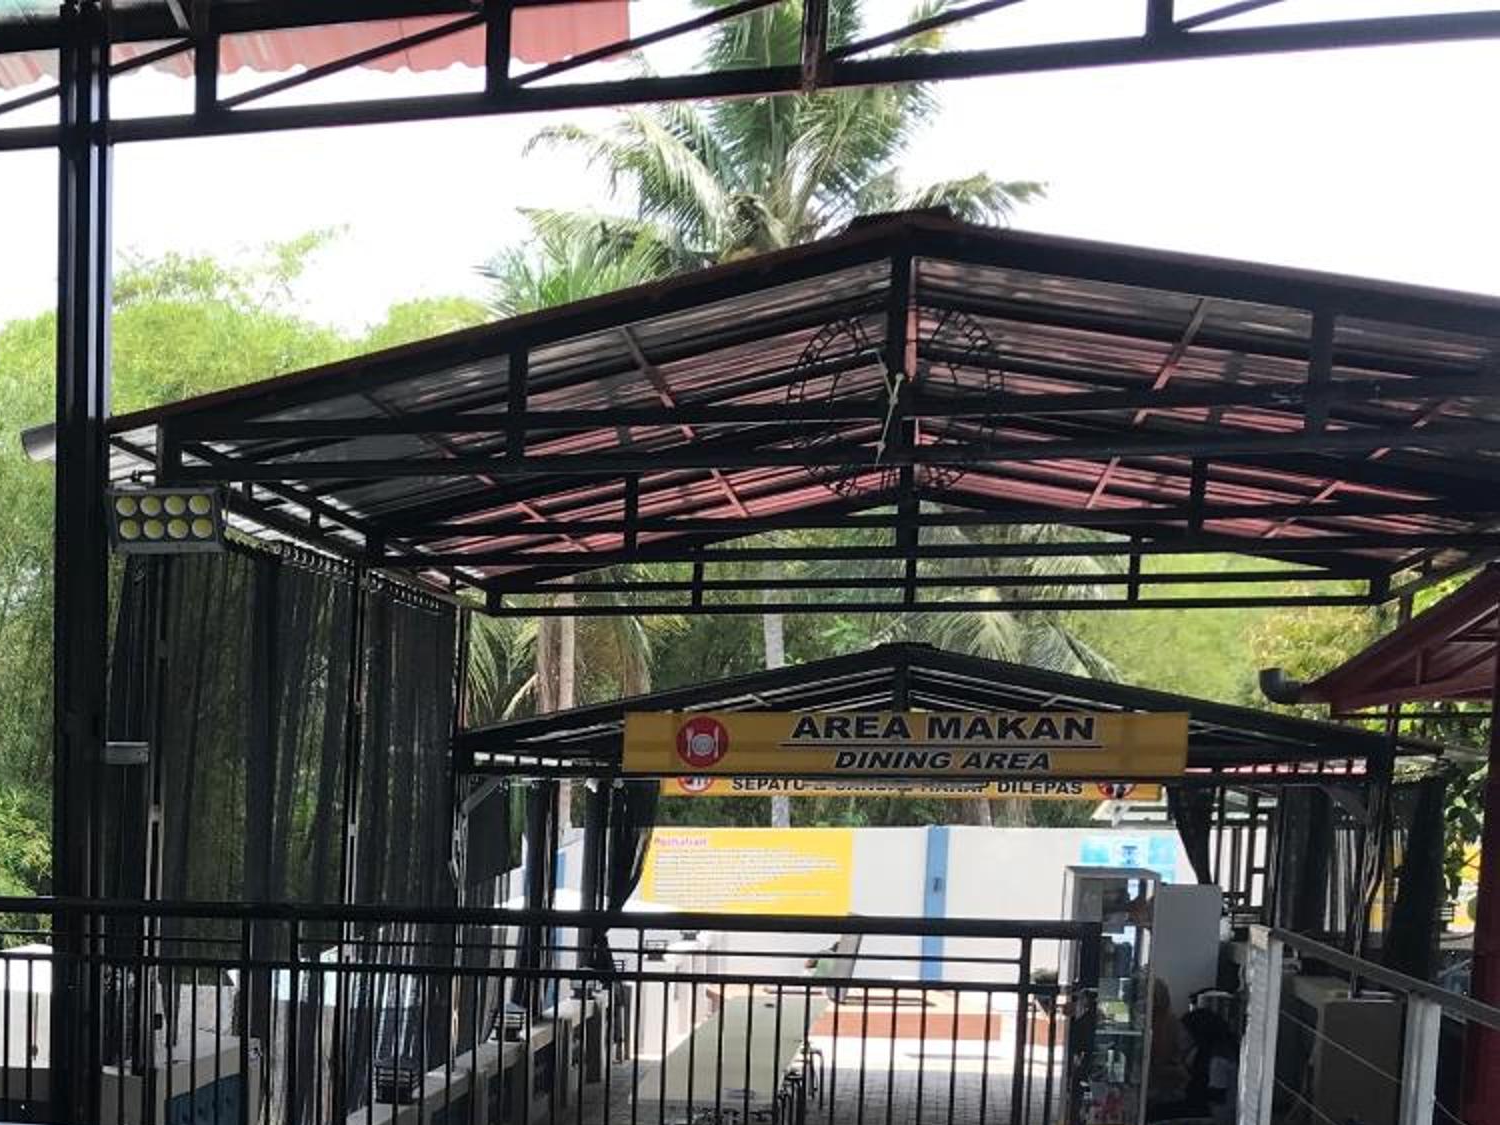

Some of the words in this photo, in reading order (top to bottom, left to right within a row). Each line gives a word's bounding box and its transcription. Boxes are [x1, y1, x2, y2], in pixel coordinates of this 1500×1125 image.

[791, 715, 912, 739] AREA
[927, 716, 1095, 740] MAKAN
[835, 751, 951, 769] DINING
[960, 751, 1050, 770] AREA
[731, 778, 805, 791] SEPATU
[996, 781, 1084, 796] DILEPAS
